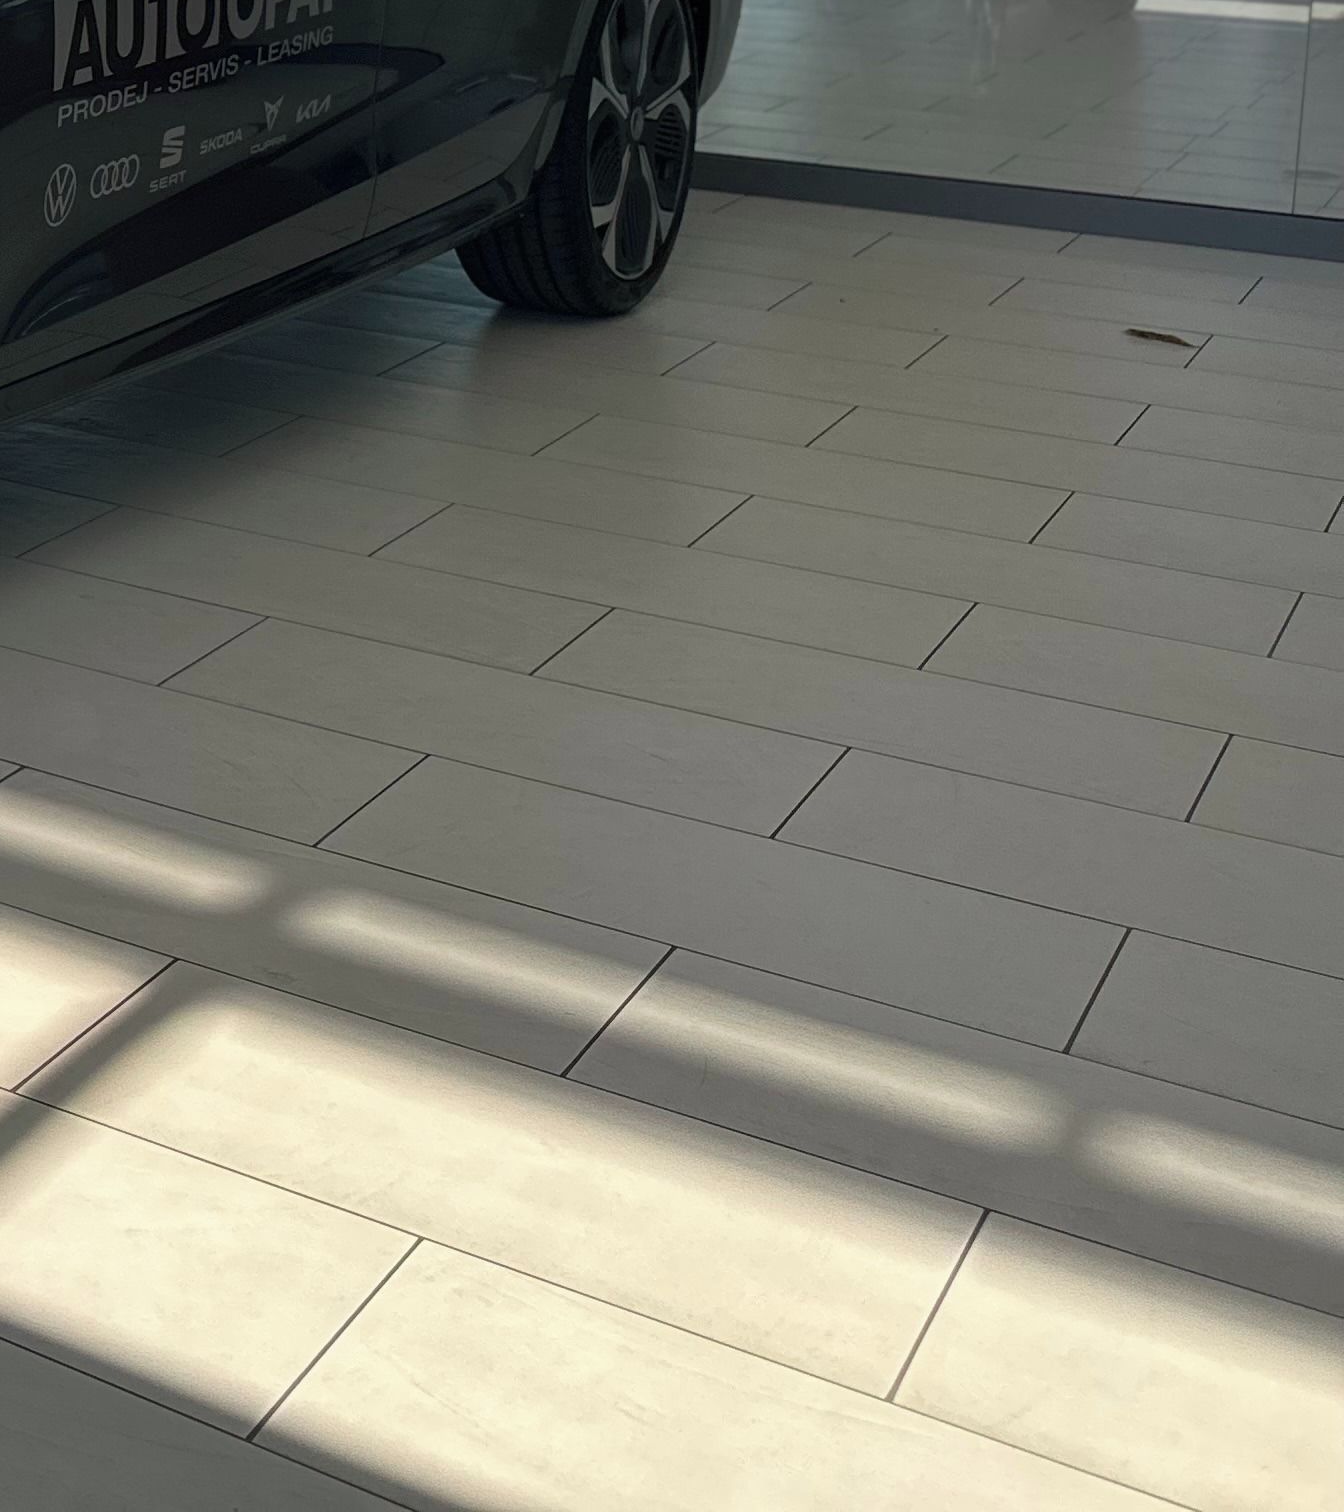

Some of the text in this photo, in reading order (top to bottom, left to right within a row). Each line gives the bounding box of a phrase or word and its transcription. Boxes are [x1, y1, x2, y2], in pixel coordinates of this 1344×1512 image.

[57, 82, 148, 128] PRODEJ
[168, 54, 239, 94] SERVIS
[256, 25, 334, 67] LEASING
[149, 170, 187, 193] SEAT
